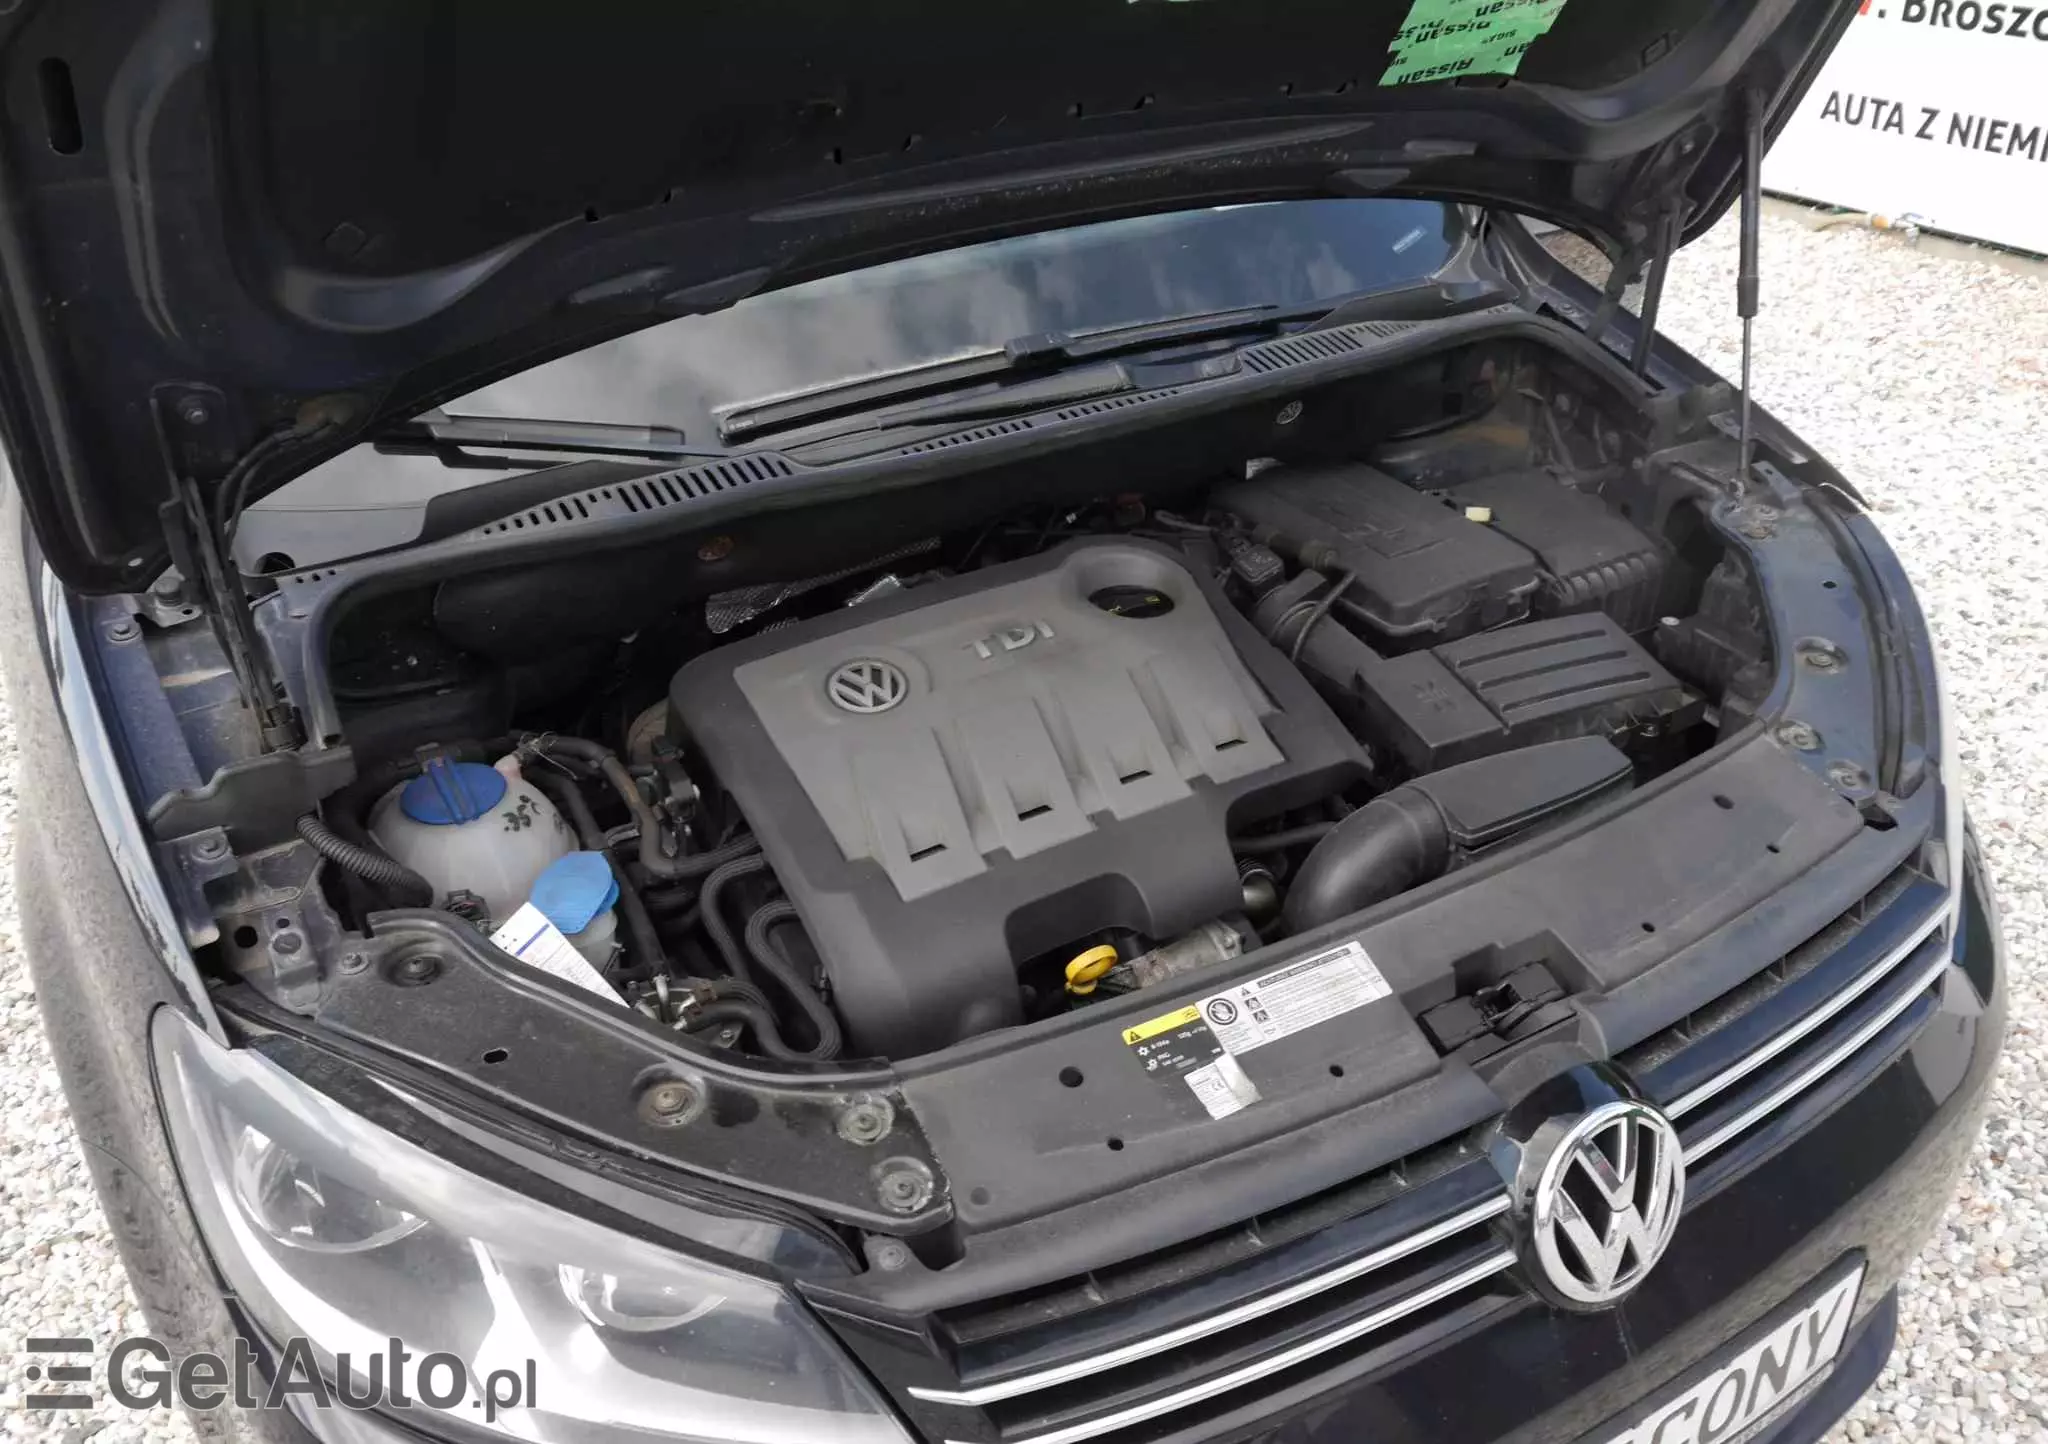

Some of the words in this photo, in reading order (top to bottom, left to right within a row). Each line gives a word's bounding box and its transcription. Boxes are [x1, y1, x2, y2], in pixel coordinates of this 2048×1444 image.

[1820, 90, 1904, 135] AUTA
[1914, 106, 1941, 140] Z
[964, 618, 1055, 660] TDI
